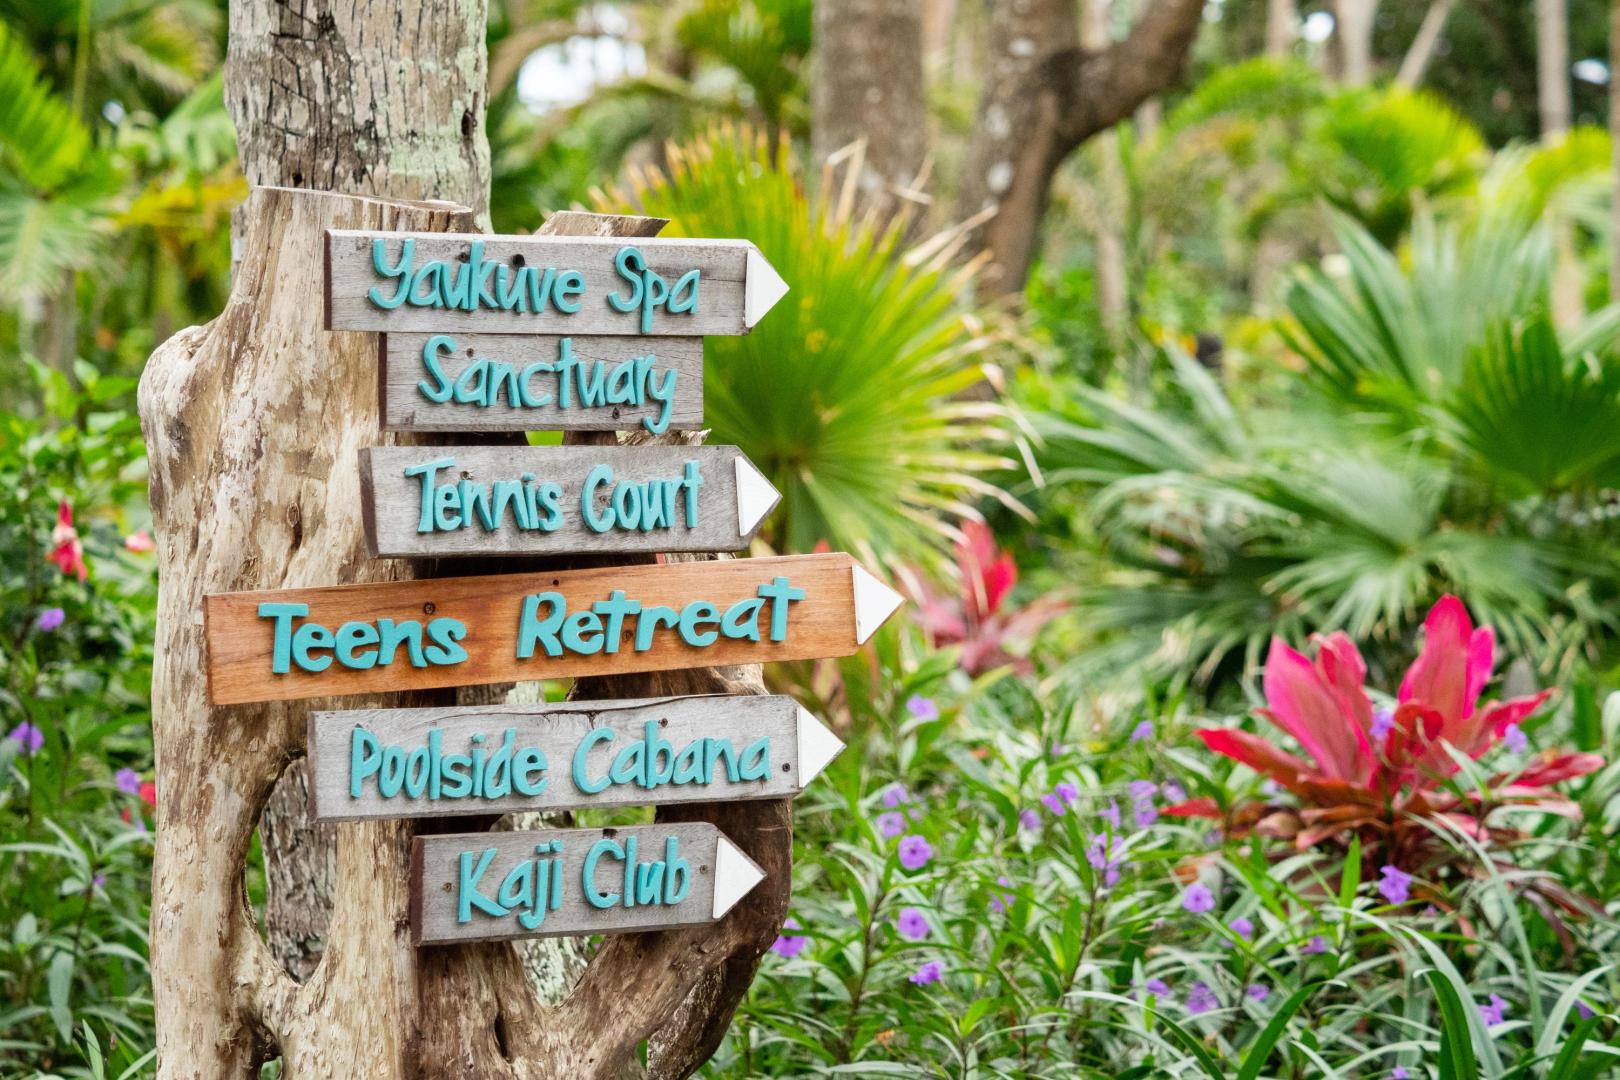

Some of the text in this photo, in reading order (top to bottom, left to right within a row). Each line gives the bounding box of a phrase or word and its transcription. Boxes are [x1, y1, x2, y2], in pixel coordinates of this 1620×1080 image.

[367, 238, 701, 334] Yaukuve Spa
[417, 335, 679, 435] Sanctuary
[404, 456, 703, 534] Tennis Court
[258, 576, 806, 674] Teens Retreat
[350, 720, 773, 800] Poolside Cabana
[457, 836, 691, 931] Kaji Club
